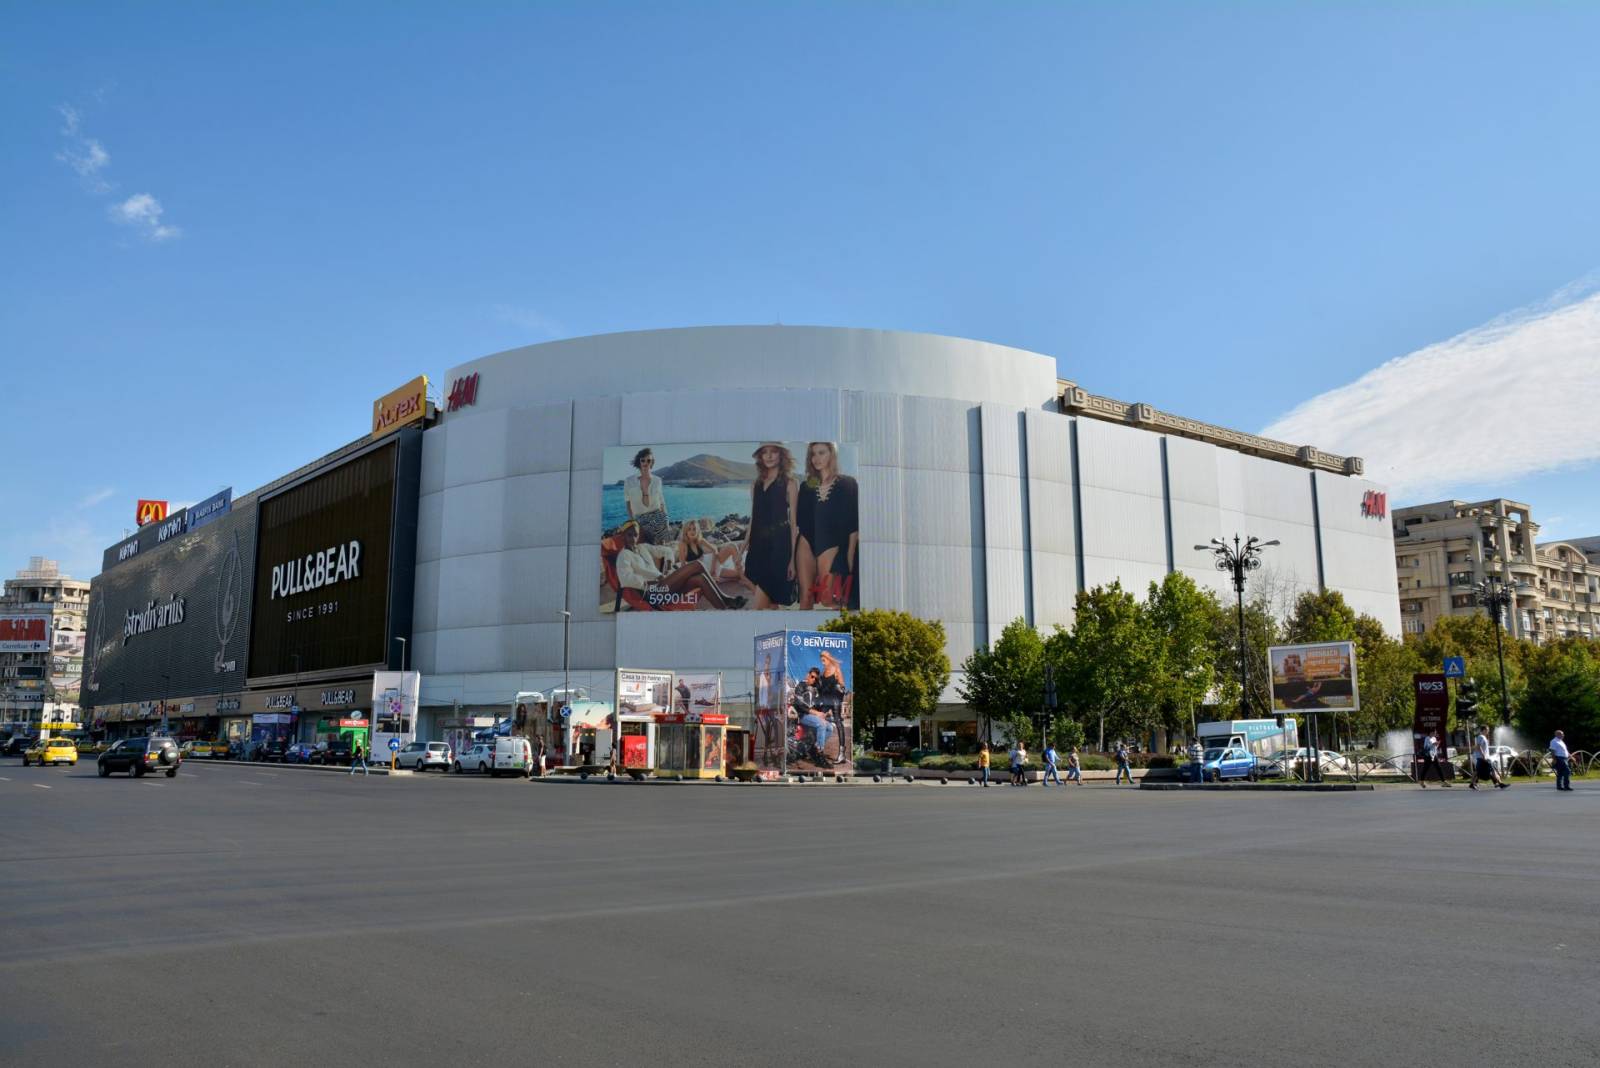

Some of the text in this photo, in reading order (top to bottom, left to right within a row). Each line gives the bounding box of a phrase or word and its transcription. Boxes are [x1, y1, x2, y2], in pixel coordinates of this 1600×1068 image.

[271, 540, 360, 600] PULL&BEAR
[680, 593, 698, 604] LEI
[287, 601, 338, 622] SINCE 1991
[803, 636, 848, 649] BENVENUTI
[265, 695, 293, 709] PULL&BEAR
[321, 689, 354, 705] PULL&BEAR
